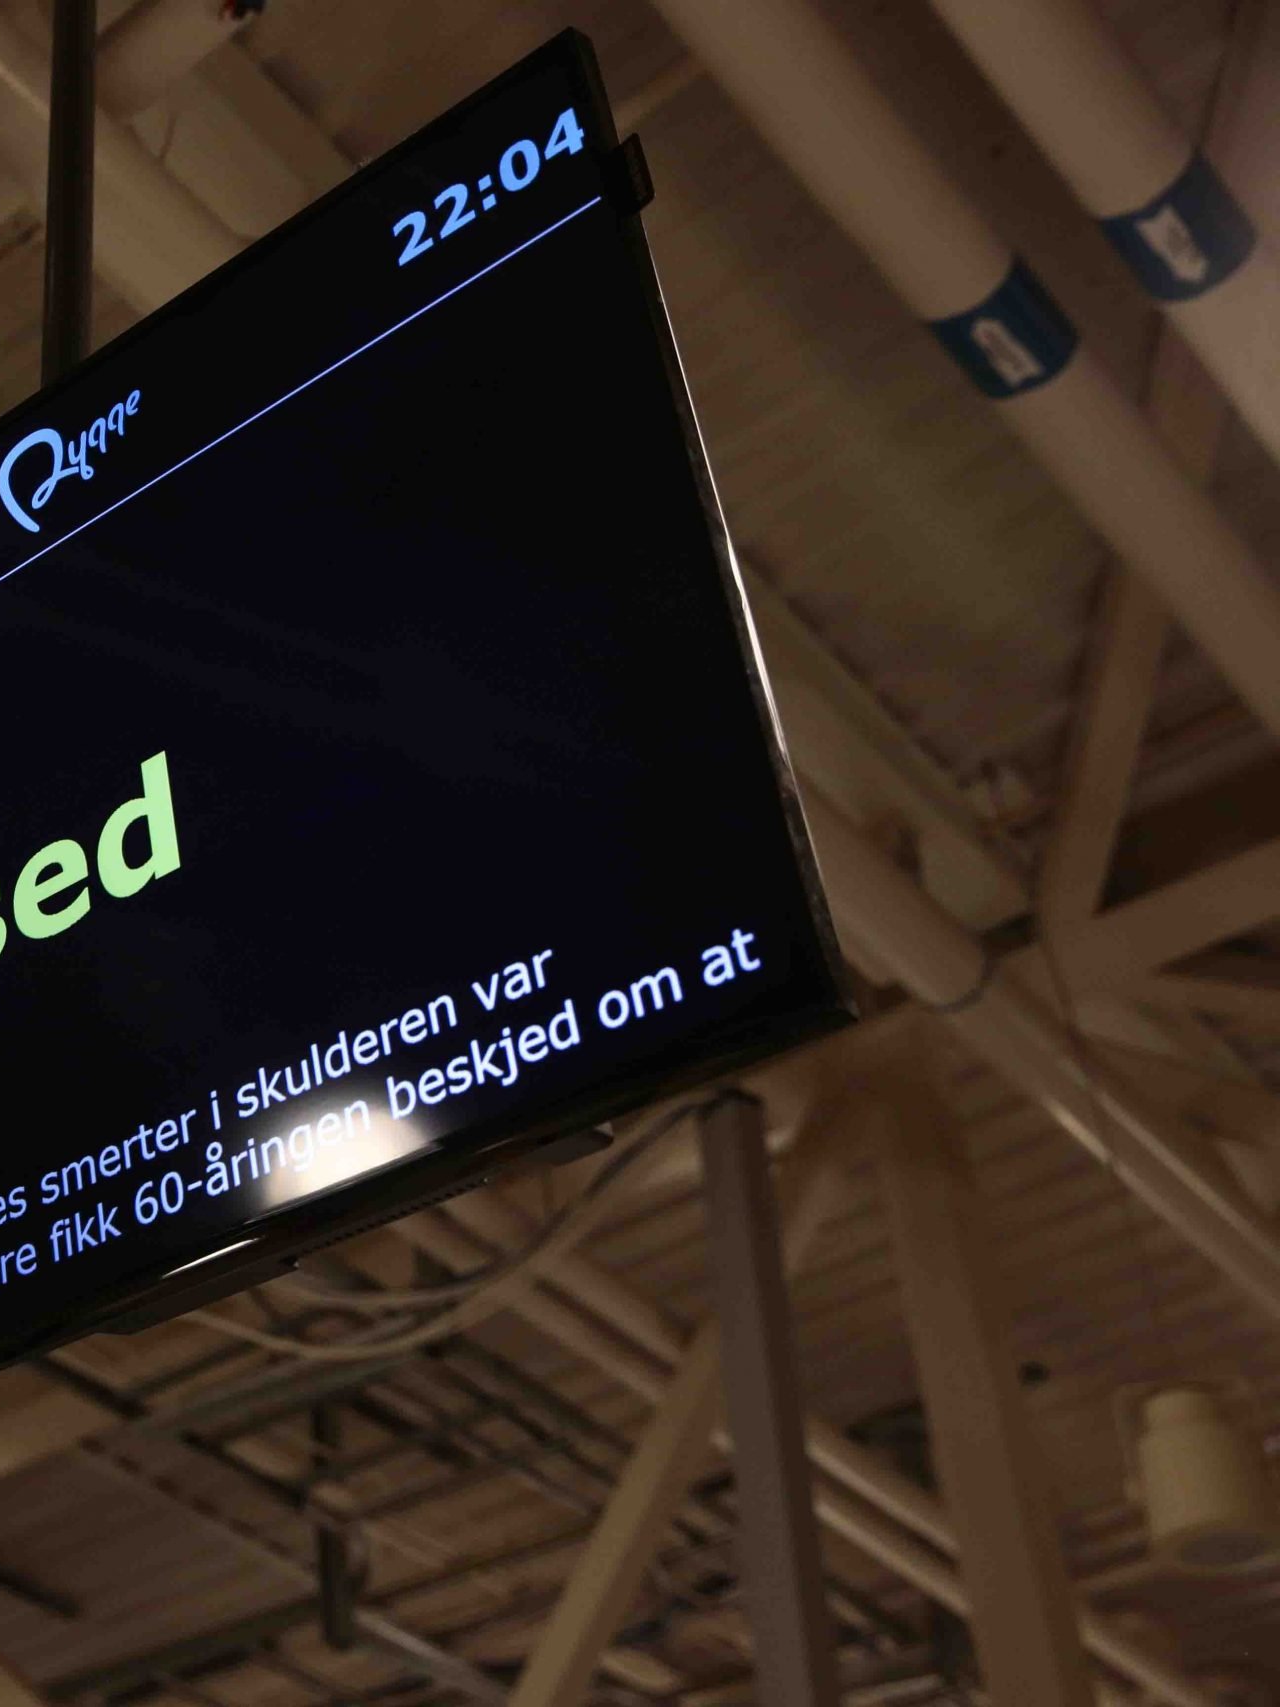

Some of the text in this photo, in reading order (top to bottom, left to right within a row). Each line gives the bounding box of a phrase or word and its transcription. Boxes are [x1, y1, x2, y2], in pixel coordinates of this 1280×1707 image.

[392, 106, 585, 267] 22:04
[40, 1109, 198, 1206] smerter
[210, 1091, 221, 1130] i
[236, 991, 458, 1119] skulderen
[471, 947, 554, 1013] var
[49, 1205, 121, 1263] fikk
[133, 1096, 372, 1227] 60-åringen
[386, 1000, 580, 1120] beskjed
[597, 964, 683, 1030] om
[701, 928, 762, 988] at
